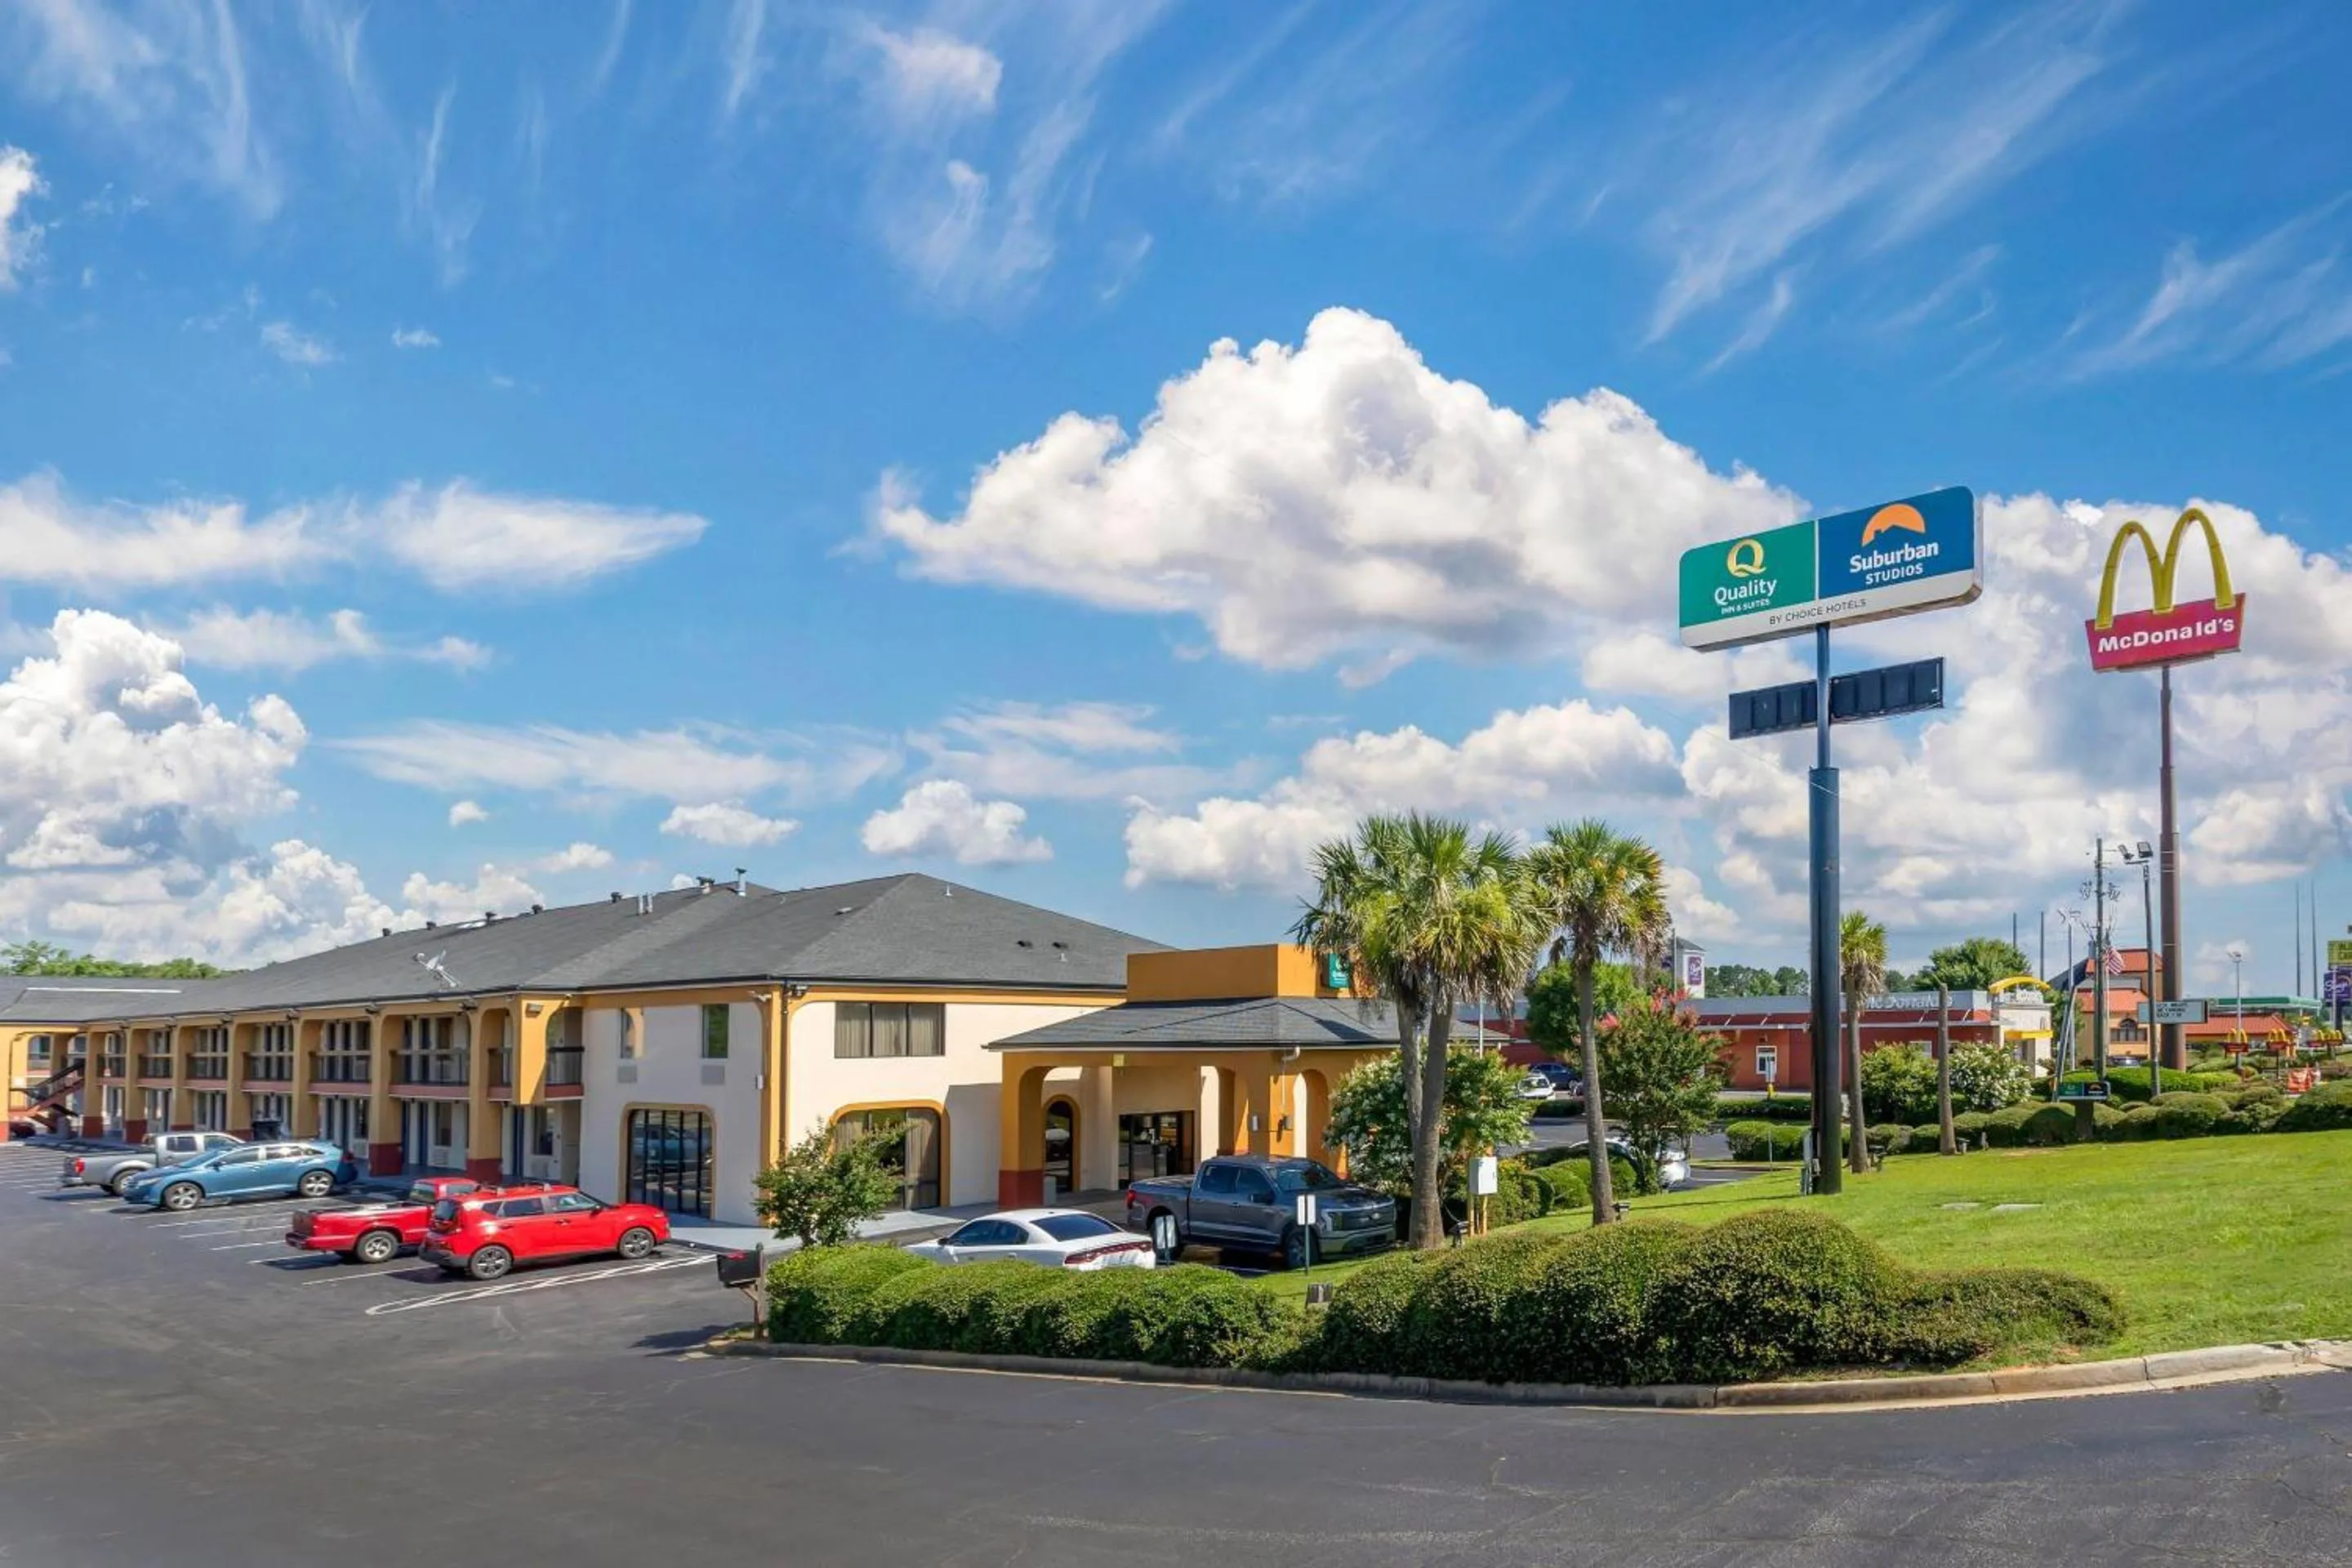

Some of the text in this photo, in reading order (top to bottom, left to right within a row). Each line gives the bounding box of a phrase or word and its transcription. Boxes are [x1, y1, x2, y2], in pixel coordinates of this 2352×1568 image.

[1726, 539, 1766, 577] Q
[1850, 541, 1940, 573] Suburban
[1865, 563, 1923, 585] STUDIOS
[1715, 579, 1777, 606] Quality
[1721, 606, 1735, 615] INN
[1743, 598, 1771, 611] SUITES
[1770, 599, 1867, 625] BY CHOICE HOTELS
[2098, 618, 2235, 653] McDonald's
